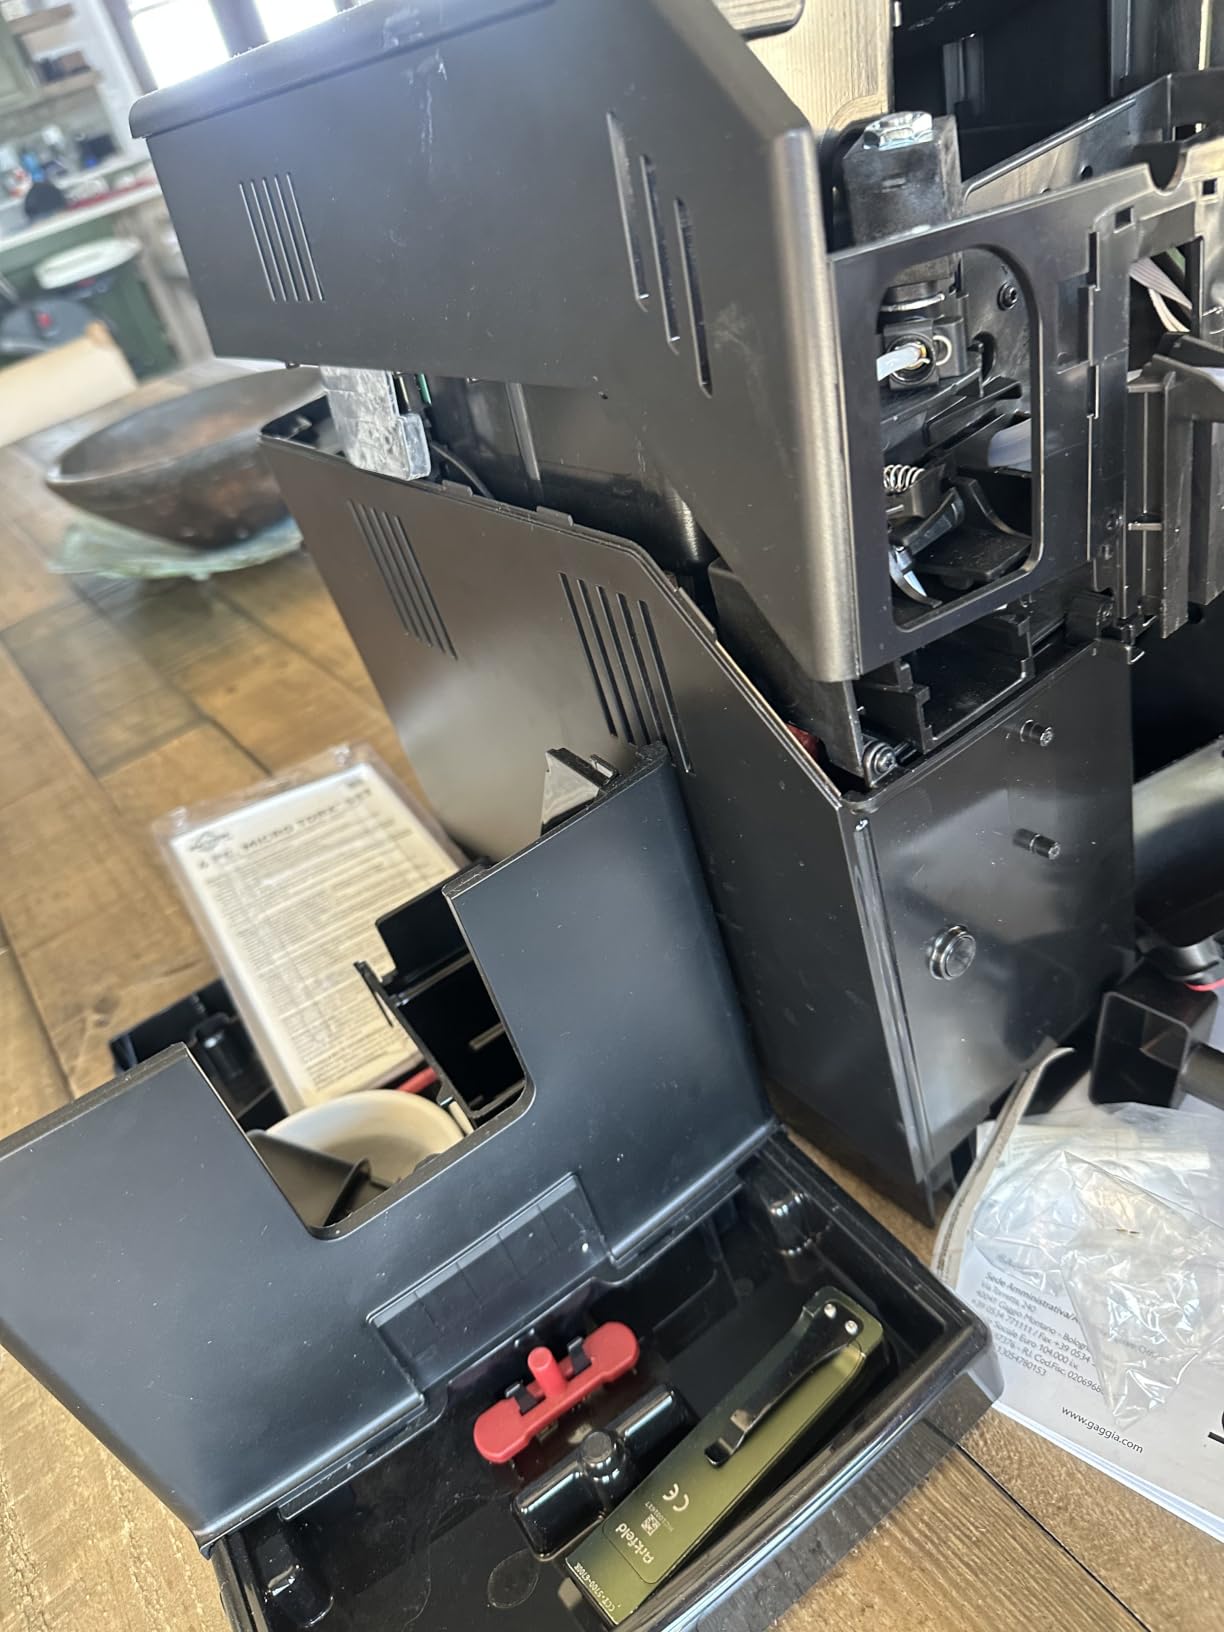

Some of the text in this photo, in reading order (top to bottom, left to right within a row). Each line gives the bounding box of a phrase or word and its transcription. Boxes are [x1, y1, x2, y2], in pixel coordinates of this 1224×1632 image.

[1018, 1333, 1037, 1348] Euro
[1038, 1343, 1069, 1364] 104.000
[1054, 1339, 1070, 1352] +39
[1069, 1347, 1090, 1363] 0534
[1060, 1406, 1143, 1453] www.gaggia.com
[615, 1523, 653, 1563] Arkfeld
